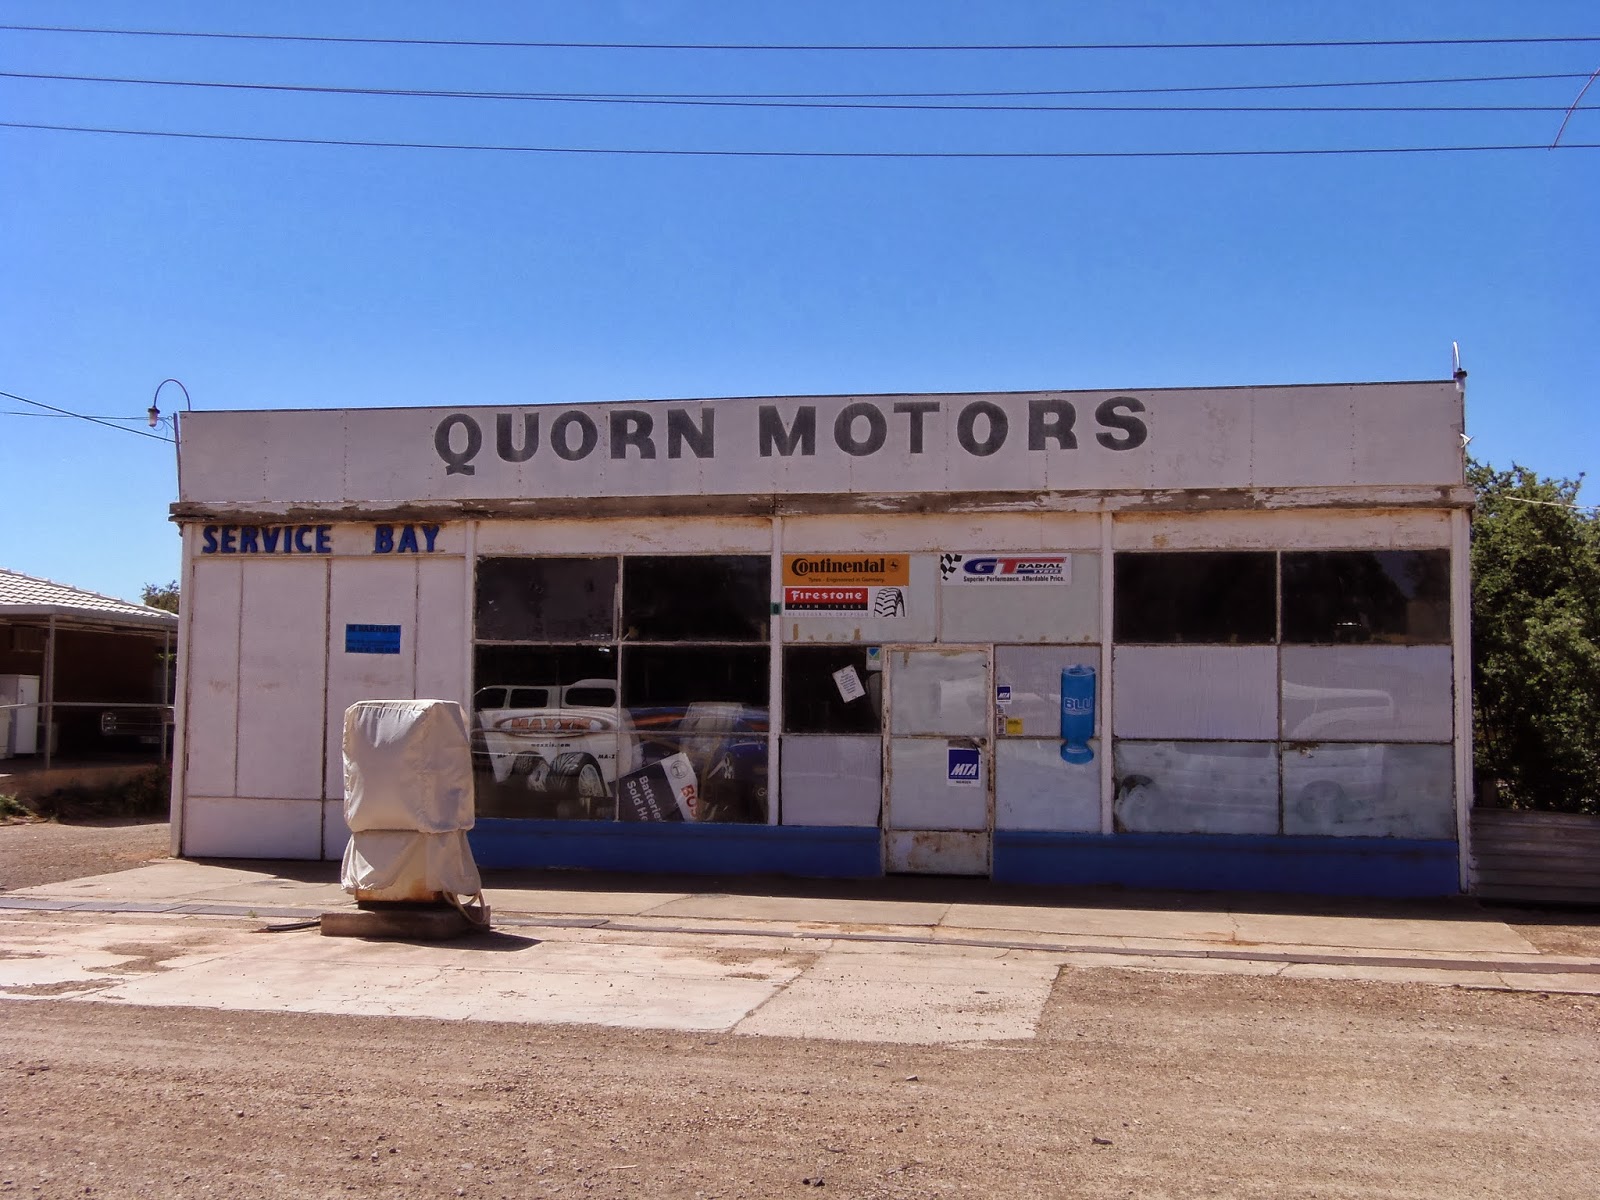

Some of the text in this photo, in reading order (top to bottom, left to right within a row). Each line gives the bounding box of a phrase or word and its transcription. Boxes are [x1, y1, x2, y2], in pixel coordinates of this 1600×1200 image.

[434, 396, 1147, 476] QUORN MOTORS
[202, 524, 440, 554] SERVICE BAY
[791, 558, 885, 576] Continental
[963, 557, 1066, 575] GT
[791, 590, 862, 601] Firestone
[1064, 697, 1093, 710] BLU
[950, 763, 977, 775] MTA
[627, 780, 644, 806] Sold
